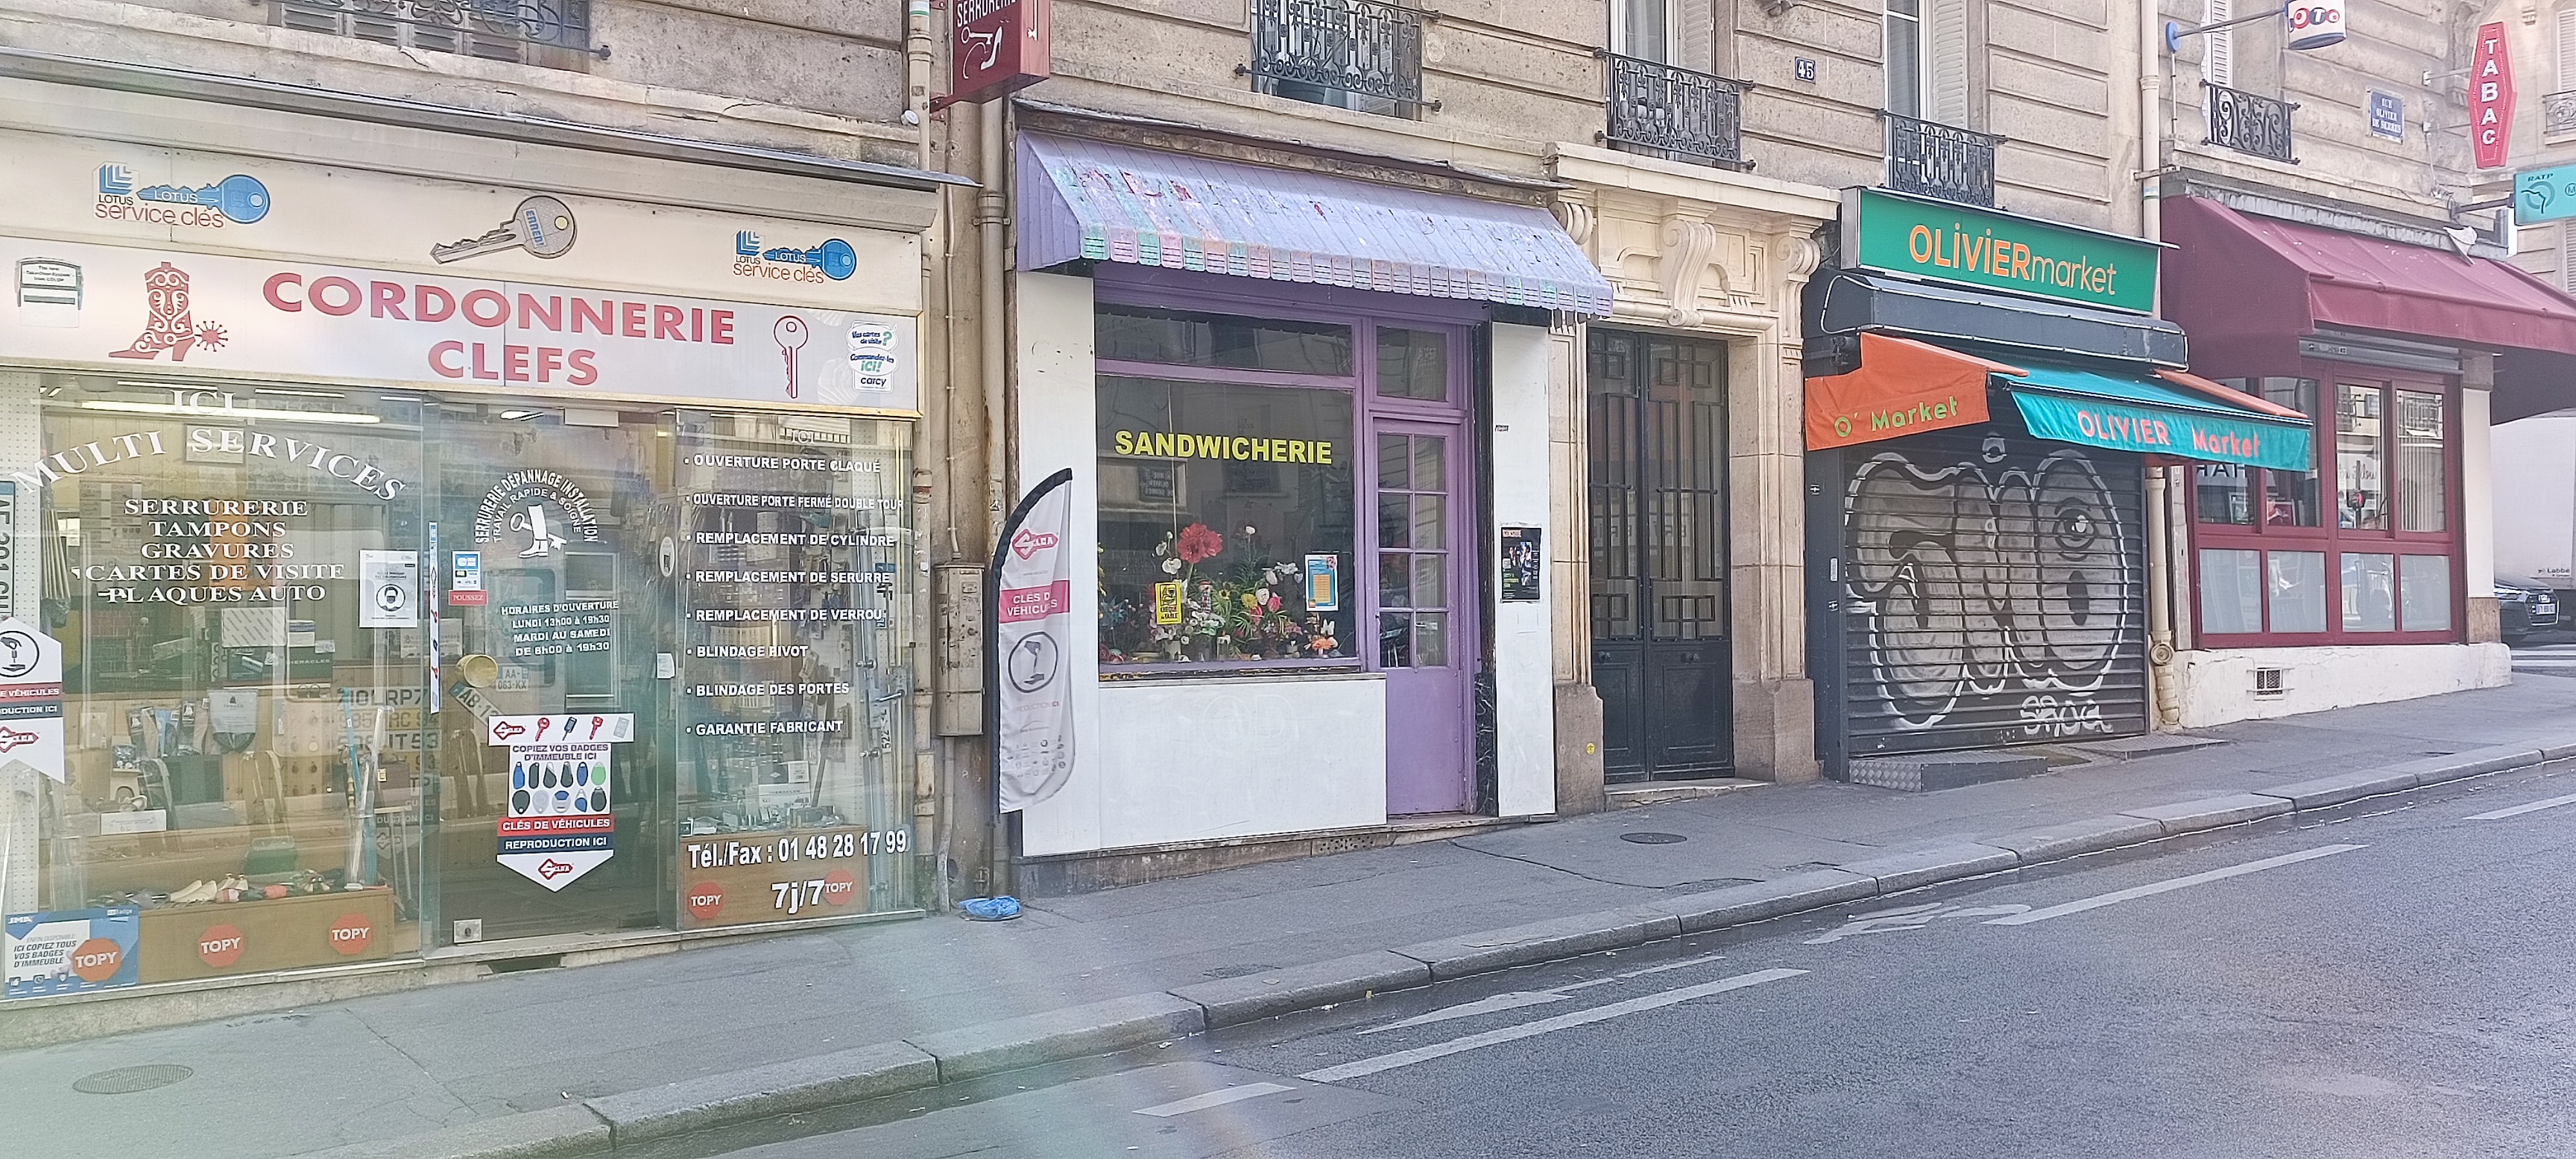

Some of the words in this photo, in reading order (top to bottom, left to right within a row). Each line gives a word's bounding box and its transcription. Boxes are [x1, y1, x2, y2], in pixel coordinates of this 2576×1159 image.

[1798, 61, 1814, 79] 45
[2480, 39, 2499, 146] TABAC
[2382, 98, 2392, 109] RUE
[2376, 108, 2397, 122] OLIVIER
[2372, 118, 2380, 127] DE
[2380, 120, 2401, 133] SERRES
[2528, 173, 2553, 182] RATP
[99, 195, 133, 206] LOTUS
[153, 189, 199, 204] LOTUS
[95, 202, 176, 225] service
[180, 206, 225, 229] clés
[735, 256, 761, 265] LOTUS
[775, 251, 806, 263] LOTUS
[733, 263, 791, 281] service
[792, 265, 824, 284] clés
[263, 272, 734, 345] CORDONNERIE
[428, 341, 598, 386] CLEFS
[170, 390, 236, 415] ICI
[1871, 395, 1958, 432] Market
[2077, 410, 2170, 446] OLIVIER
[2192, 426, 2260, 458] Market
[1114, 430, 1332, 464] SANDWICHERIE
[9, 430, 166, 495] MULTI
[191, 428, 407, 502] SERVICES
[694, 455, 779, 469] OUVERTURE
[782, 457, 826, 471] PORTE
[829, 458, 881, 473] CLAQUÉ
[124, 498, 308, 517] SERRURERIE
[475, 484, 507, 544] SERRURERIE
[500, 469, 563, 492] DÉPANNAGE
[560, 479, 598, 543] INSTALLATION
[693, 494, 759, 507] OUVERTURE
[761, 495, 796, 508] PORTE
[798, 495, 833, 509] FERMÉ
[834, 497, 875, 510] DOUBLE
[876, 498, 904, 511] TOUR
[493, 502, 512, 543] TRAVAIL
[509, 487, 549, 504] RAPIDE
[549, 491, 558, 501] &
[147, 521, 286, 538] TAMPONS
[696, 532, 806, 545] REMPLACEMENT
[809, 534, 828, 546] DE
[829, 534, 895, 547] CYLINDRE
[140, 542, 295, 560] GRAVURES
[84, 564, 202, 581] CARTES
[209, 564, 248, 581] DE
[254, 564, 345, 581] VISITE
[696, 570, 806, 583] REMPLACEMENT
[809, 571, 828, 583] DE
[829, 571, 891, 584] SERURRE
[106, 585, 243, 605] PLAQUES
[247, 584, 326, 602] AUTO
[1013, 592, 1041, 605] CLÉS
[500, 603, 551, 616] HORAIRES
[553, 600, 619, 614] D'OUVERTURE
[696, 609, 806, 622] REMPLACEMENT
[809, 609, 828, 621] DE
[830, 608, 882, 621] VERROU
[511, 617, 542, 629] LUNDI
[574, 614, 581, 625] à
[582, 614, 610, 625] 19h30
[513, 632, 549, 643] MARDI
[553, 631, 567, 640] AU
[570, 627, 611, 639] SAMEDI
[515, 645, 532, 657] DE
[535, 644, 562, 655] 8h00
[565, 643, 573, 653] à
[576, 641, 610, 652] 19h30
[696, 645, 766, 658] BLINDAGE
[8, 688, 59, 697] VÉHICULES
[696, 684, 765, 697] BLINDAGE
[769, 683, 795, 696] DES
[798, 682, 850, 695] PORTES
[0, 706, 43, 715] DUCTION
[696, 722, 766, 737] GARANTIE
[769, 720, 844, 735] FABRICANT
[512, 745, 547, 753] COPIEZ
[571, 744, 609, 752] BADGES
[524, 752, 582, 762] D'IMMEUBLE
[584, 752, 597, 760] ICI
[502, 819, 531, 832] CLÉS
[533, 820, 549, 831] DE
[551, 818, 611, 829] VÉHICULES
[505, 837, 590, 850] REPRODUCTION
[592, 836, 607, 847] ICI
[687, 840, 762, 869] Tél./Fax
[778, 837, 799, 862] 01
[805, 835, 828, 860] 48
[832, 833, 855, 858] 28
[860, 831, 882, 856] 17
[885, 829, 907, 854] 99
[824, 881, 853, 894] TOPY
[690, 894, 723, 907] TOPY
[771, 879, 826, 914] 7j/7
[44, 934, 75, 942] DISPONIBLE
[331, 926, 370, 941] TOPY
[26, 942, 55, 951] COPIEZ
[56, 940, 77, 948] TOUS
[200, 936, 242, 955] TOPY
[32, 949, 64, 959] BADGES
[75, 951, 118, 969] TOPY
[14, 957, 64, 968] D'IMMEUBLE
